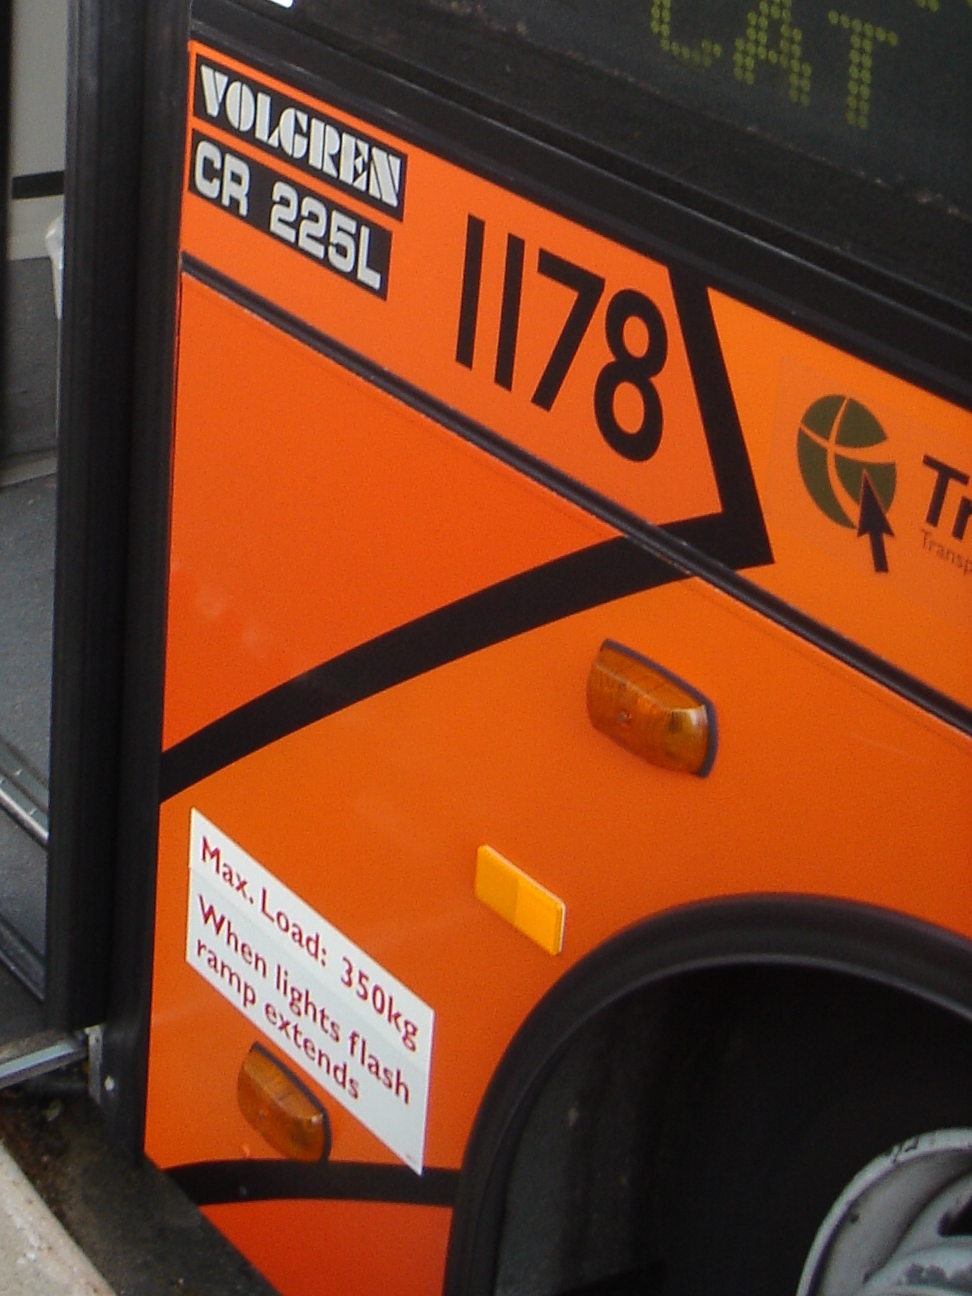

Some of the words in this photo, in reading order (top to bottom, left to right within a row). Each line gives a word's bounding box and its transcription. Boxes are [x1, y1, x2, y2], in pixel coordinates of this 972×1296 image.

[194, 140, 251, 217] CR
[269, 180, 381, 290] 225L
[201, 64, 402, 207] VOLGREN
[455, 213, 668, 462] 1178
[196, 938, 257, 1008] ramp
[265, 1002, 360, 1100] extends
[198, 894, 268, 978] When
[276, 963, 341, 1043] lights
[349, 1030, 410, 1105] flash
[200, 835, 254, 904] Max.
[260, 886, 327, 967] Load:
[340, 956, 419, 1053] 350kg
